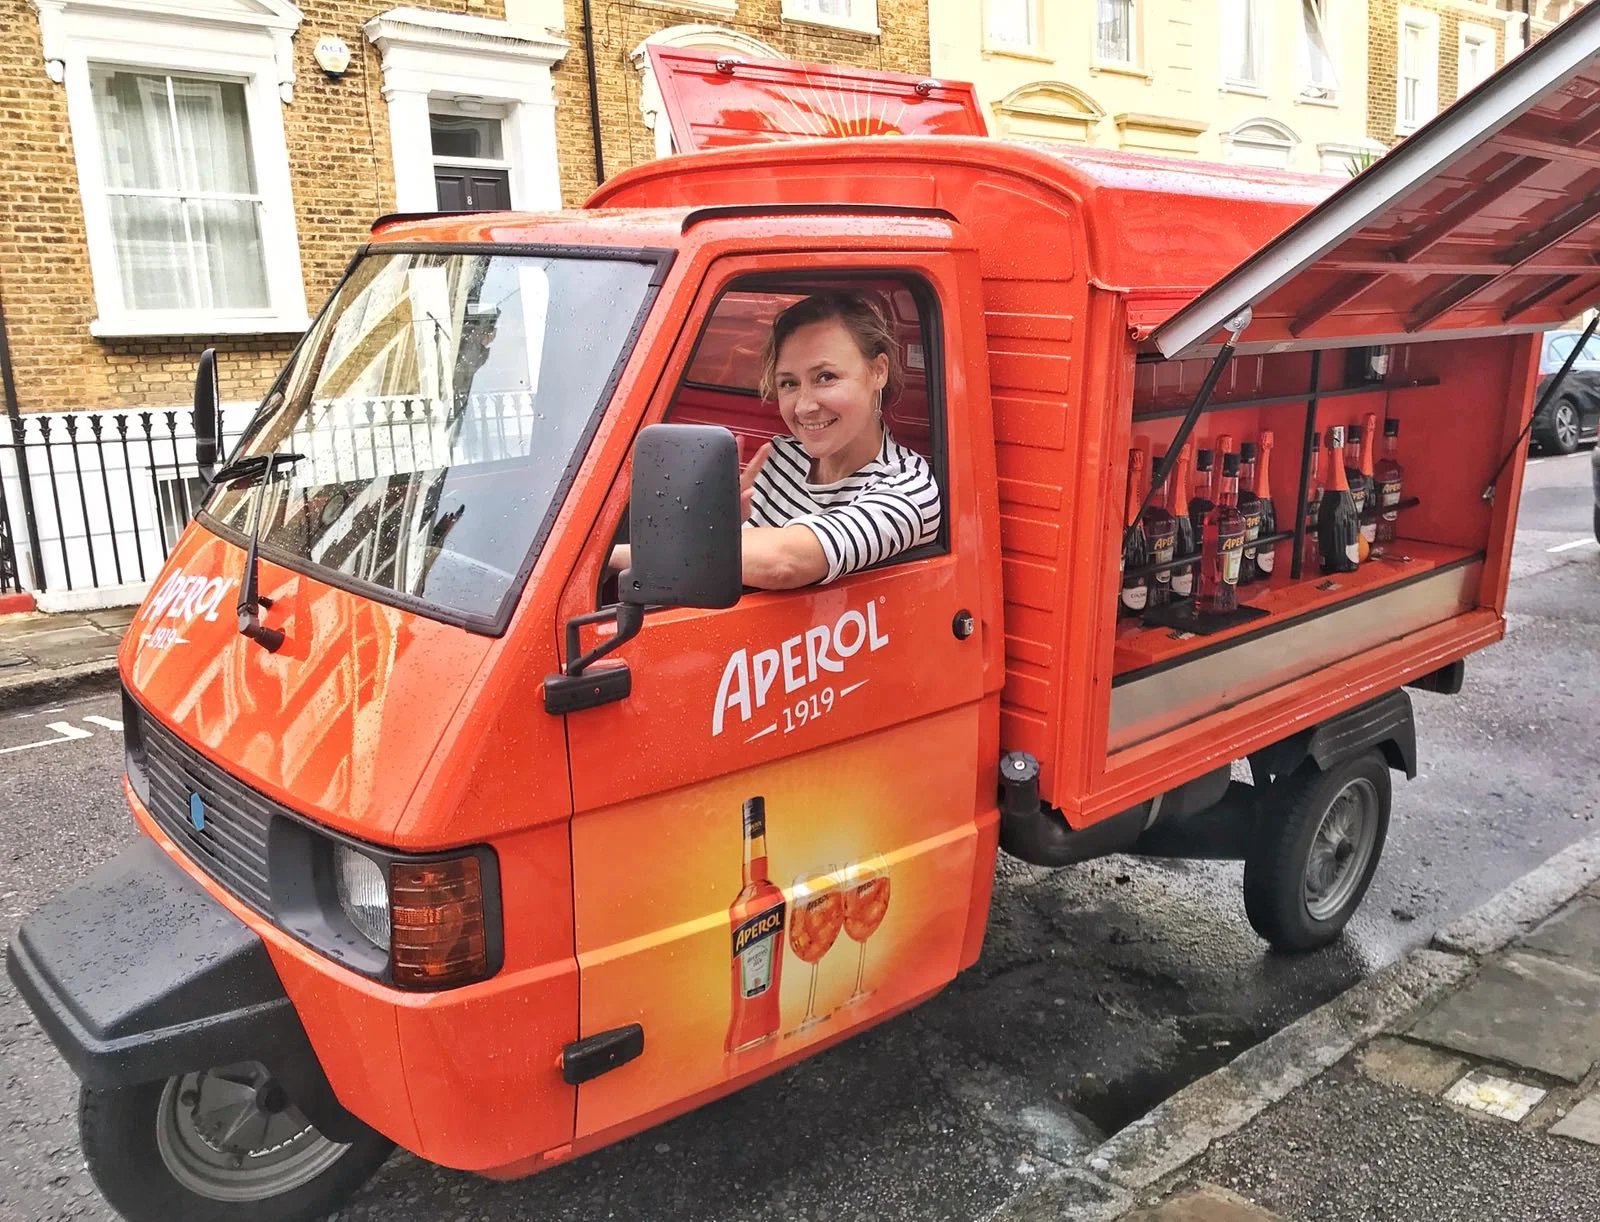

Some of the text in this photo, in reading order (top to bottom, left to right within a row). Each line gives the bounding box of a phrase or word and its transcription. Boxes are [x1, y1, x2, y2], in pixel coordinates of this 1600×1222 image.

[467, 195, 473, 205] 8
[140, 567, 234, 623] APEROL
[782, 687, 835, 734] 1919
[735, 911, 781, 952] APEROL
